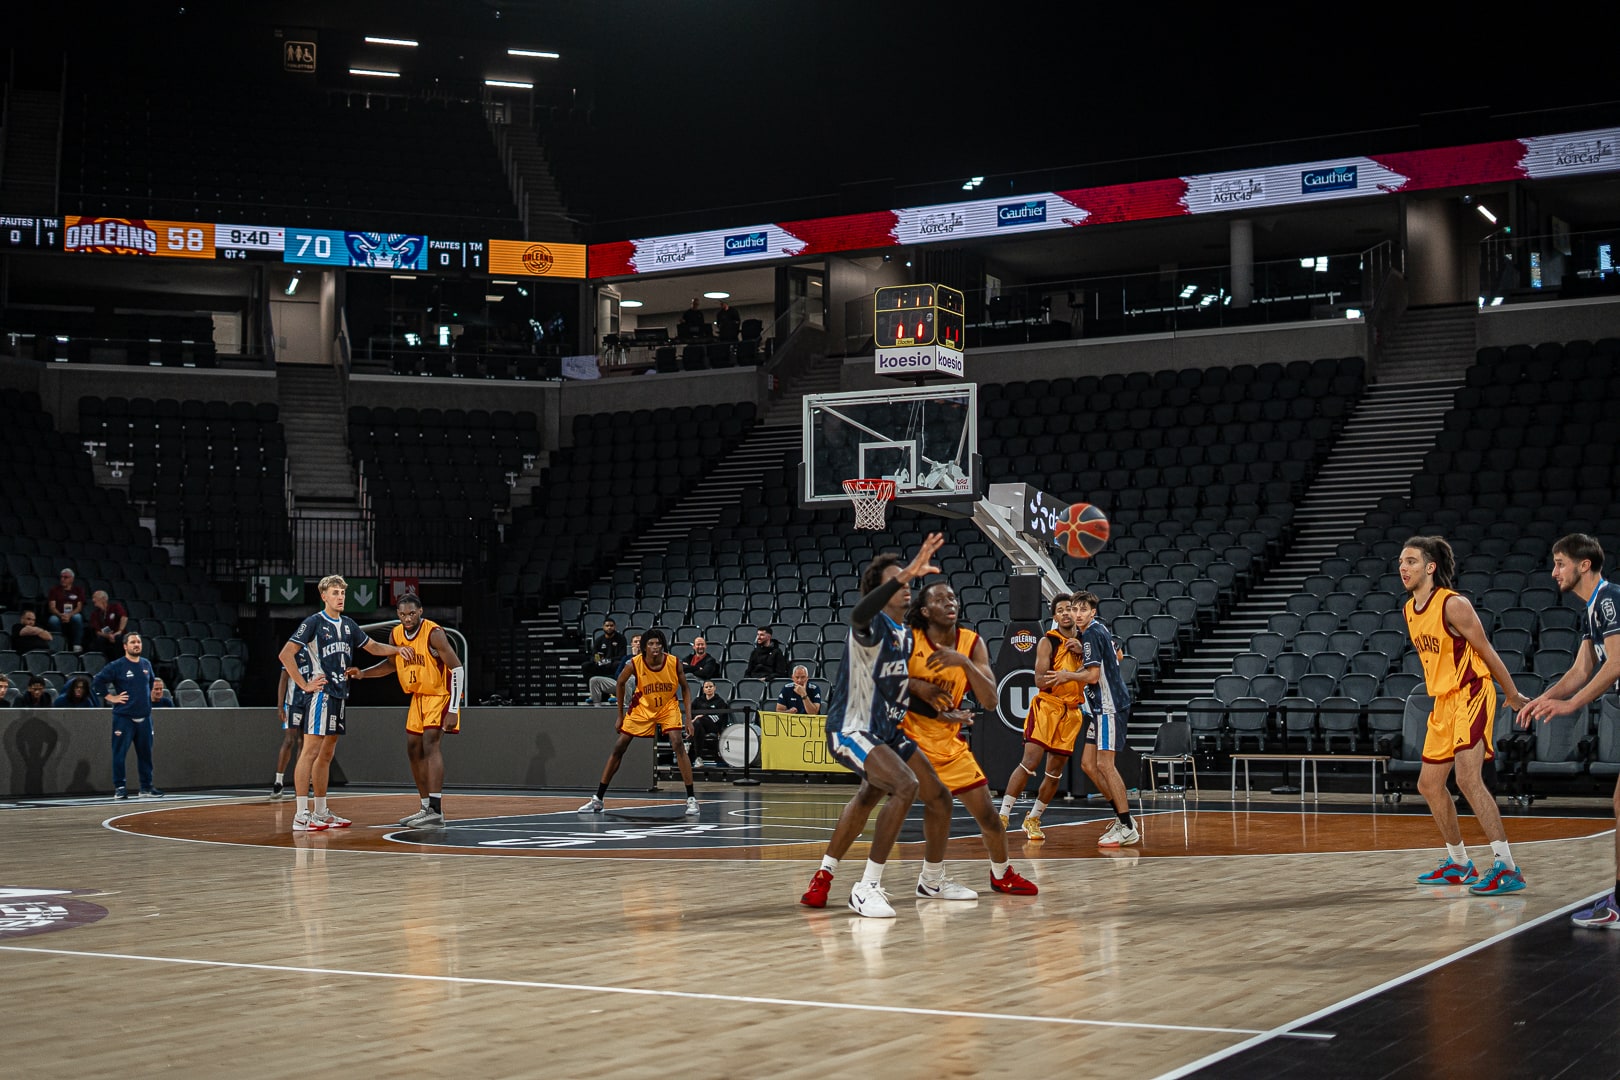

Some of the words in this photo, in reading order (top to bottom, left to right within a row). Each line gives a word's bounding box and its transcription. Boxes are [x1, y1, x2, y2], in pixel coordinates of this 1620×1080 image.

[1556, 153, 1600, 165] AGTC45
[1304, 171, 1355, 186] Gauthier
[1213, 191, 1252, 203] AGTC45
[1000, 205, 1044, 220] Gauthier
[0, 217, 33, 227] FAUTES
[43, 218, 58, 228] TM
[920, 224, 954, 235] AGTC45
[10, 229, 20, 242] 0
[47, 232, 55, 244] 1
[168, 227, 204, 251] 58
[230, 230, 270, 246] 9:40
[296, 235, 331, 259] 70
[430, 240, 460, 250] FAUTES
[469, 242, 483, 251] TM
[726, 237, 766, 250] Gauthier
[239, 250, 246, 259] 4
[440, 253, 449, 265] 0
[473, 255, 480, 267] 1
[656, 253, 686, 264] AGTC45
[880, 352, 931, 368] koesio
[938, 351, 962, 371] koesio
[654, 697, 662, 707] 11
